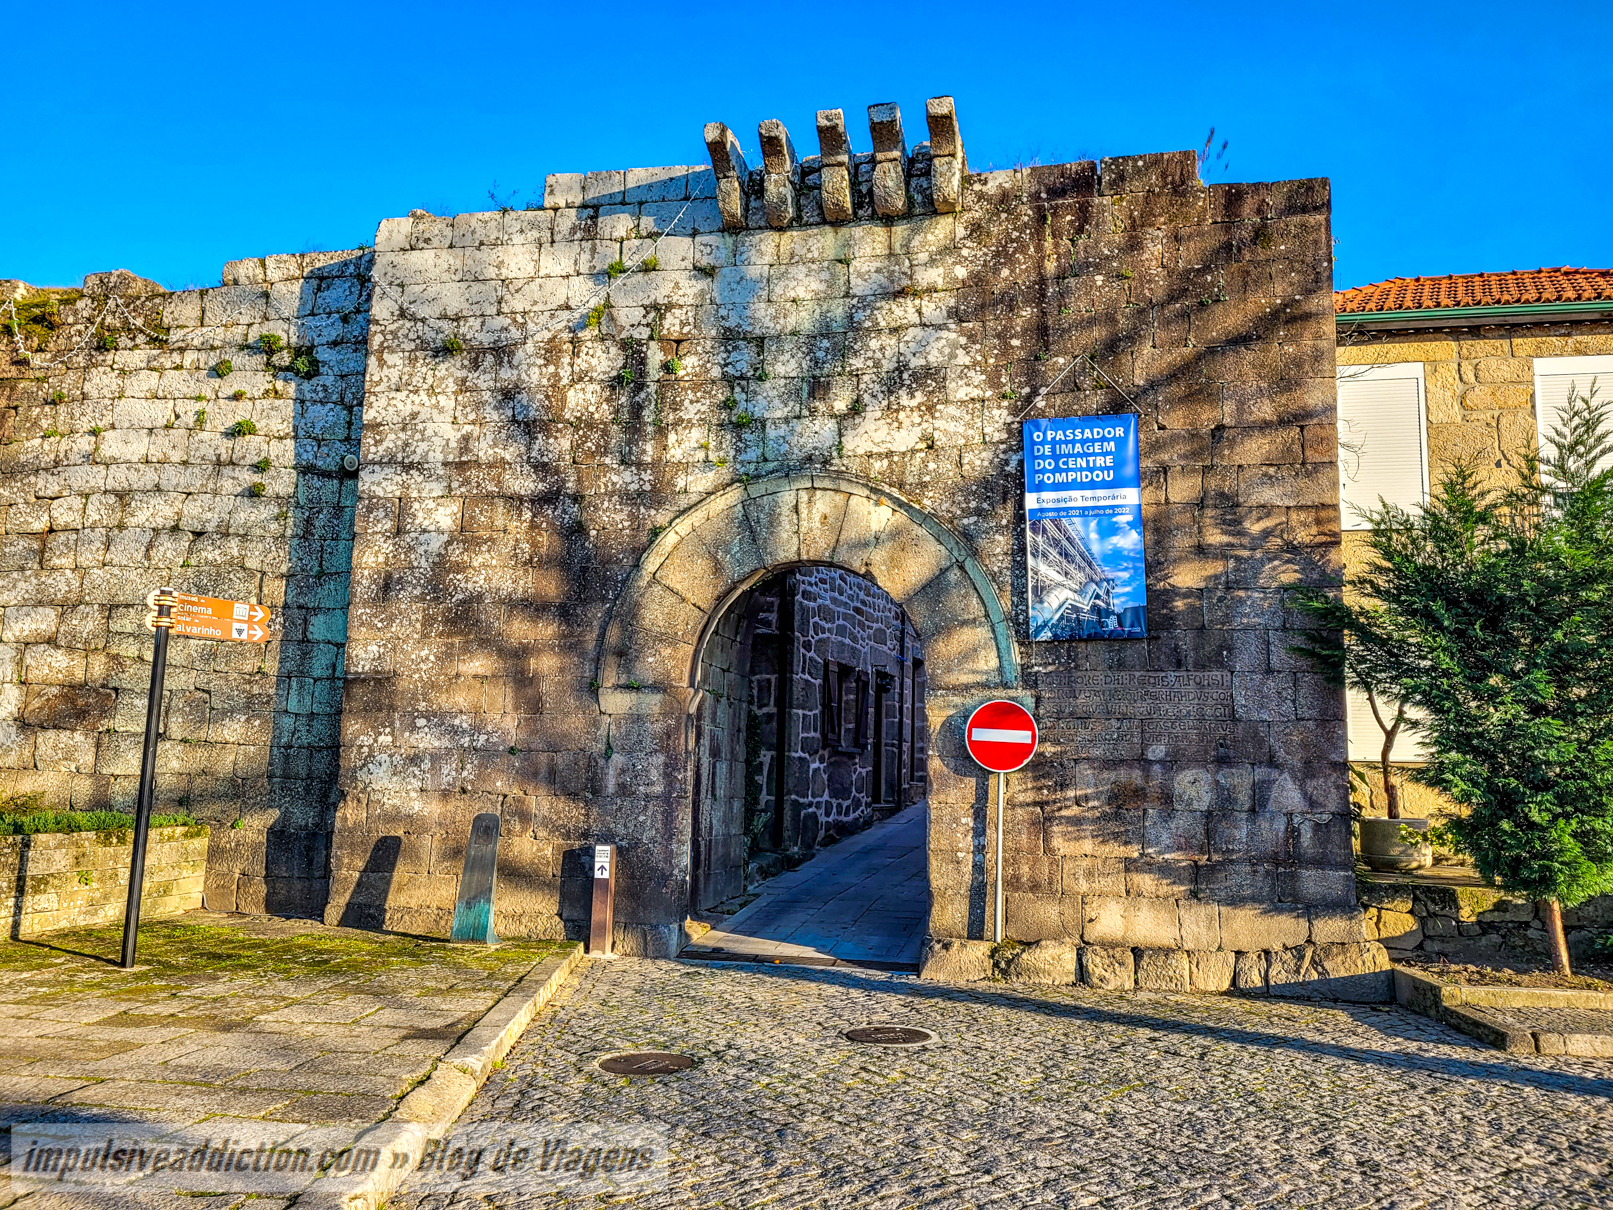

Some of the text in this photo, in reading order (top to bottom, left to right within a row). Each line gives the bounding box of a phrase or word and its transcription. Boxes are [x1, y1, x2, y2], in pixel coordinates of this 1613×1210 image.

[1033, 427, 1125, 442] O PASSADOR
[1034, 441, 1115, 456] DE IMAGEM
[1034, 455, 1114, 470] DO CENTRE
[1035, 470, 1114, 485] POMPIDOU
[1036, 493, 1127, 505] Exposição Temporária
[1089, 508, 1104, 516] julho
[178, 602, 212, 615] cinema
[175, 623, 222, 636] alvarinho
